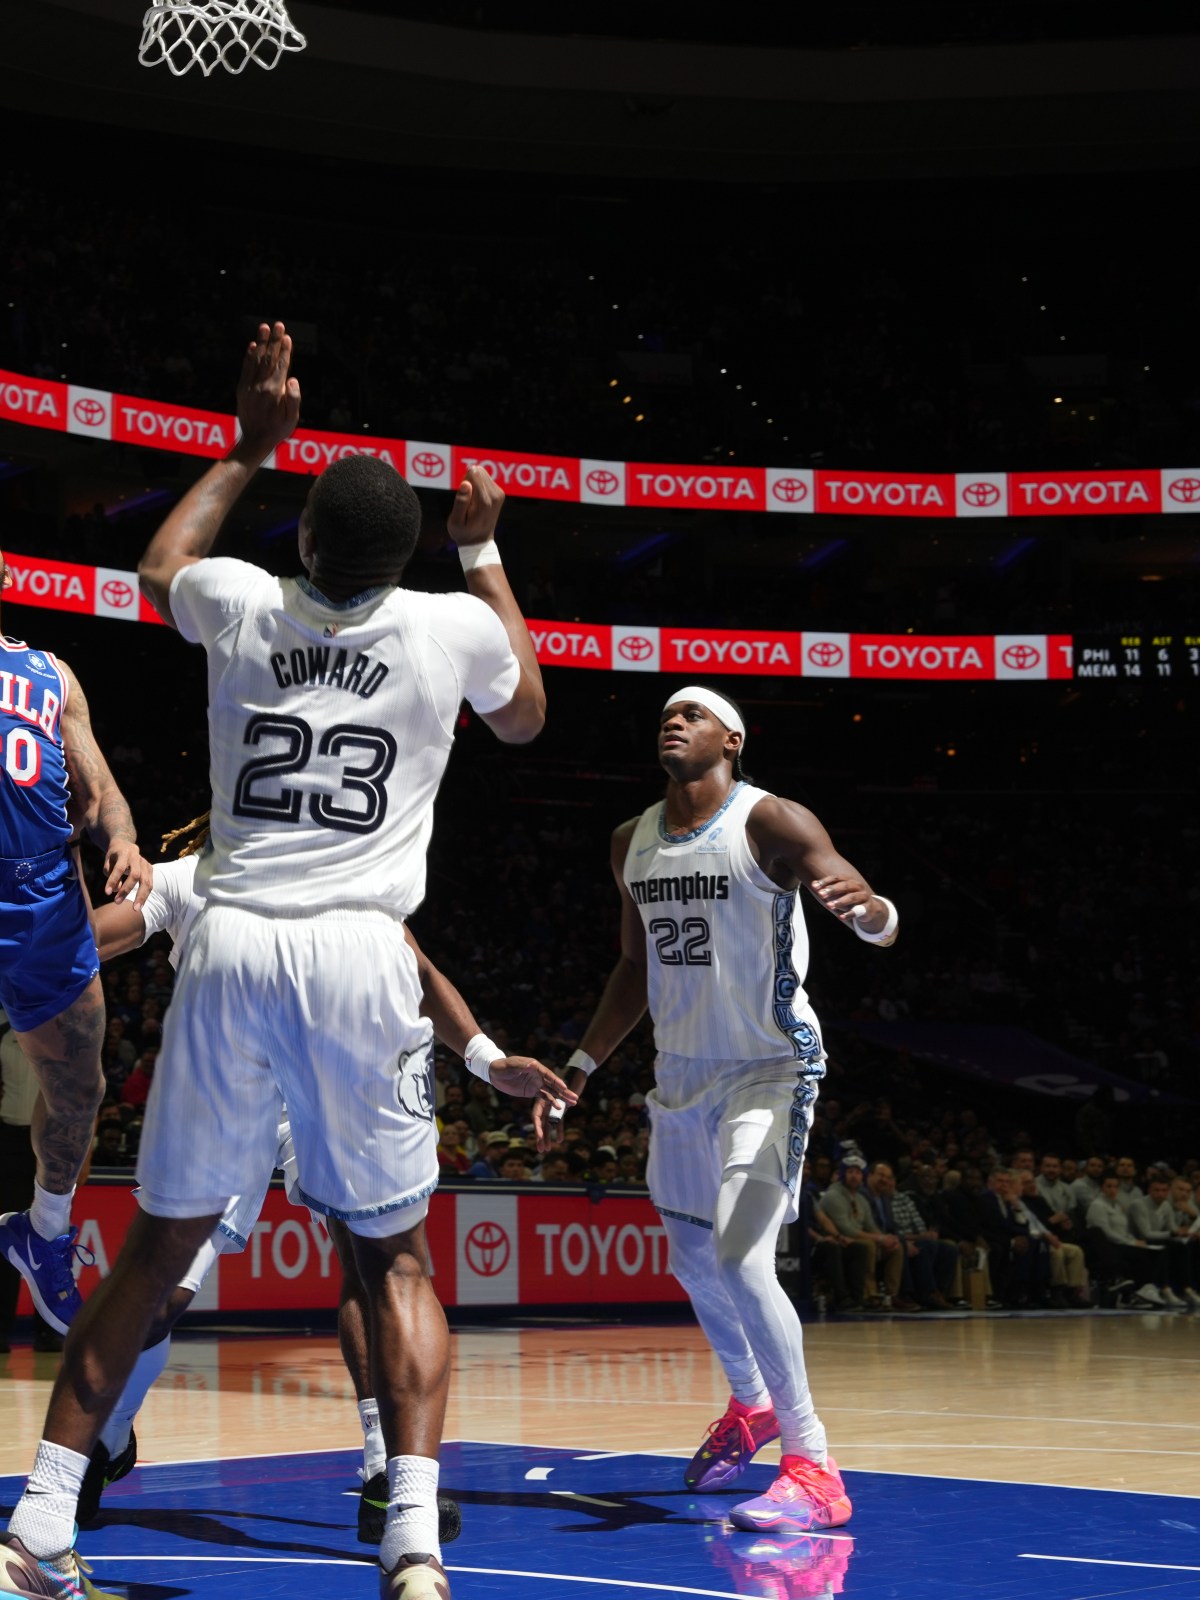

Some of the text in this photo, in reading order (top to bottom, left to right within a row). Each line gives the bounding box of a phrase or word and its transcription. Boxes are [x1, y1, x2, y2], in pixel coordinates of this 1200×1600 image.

[122, 408, 224, 447] TOYOTA
[637, 475, 754, 498] TOYOTA
[826, 482, 942, 505] TOYOTA
[1020, 482, 1148, 504] TOYOTA
[672, 640, 790, 663] TOYOTA
[862, 645, 982, 668] TOYOTA
[1083, 649, 1110, 661] PHI
[1125, 648, 1140, 661] 11
[1158, 648, 1169, 661] 6
[1189, 648, 1199, 661] 3
[270, 646, 390, 700] COWARD
[1078, 664, 1200, 677] MEM 14 11 1
[232, 713, 398, 835] 23
[630, 871, 729, 906] memphis
[648, 917, 712, 967] 22
[535, 1222, 674, 1276] TOYOT
